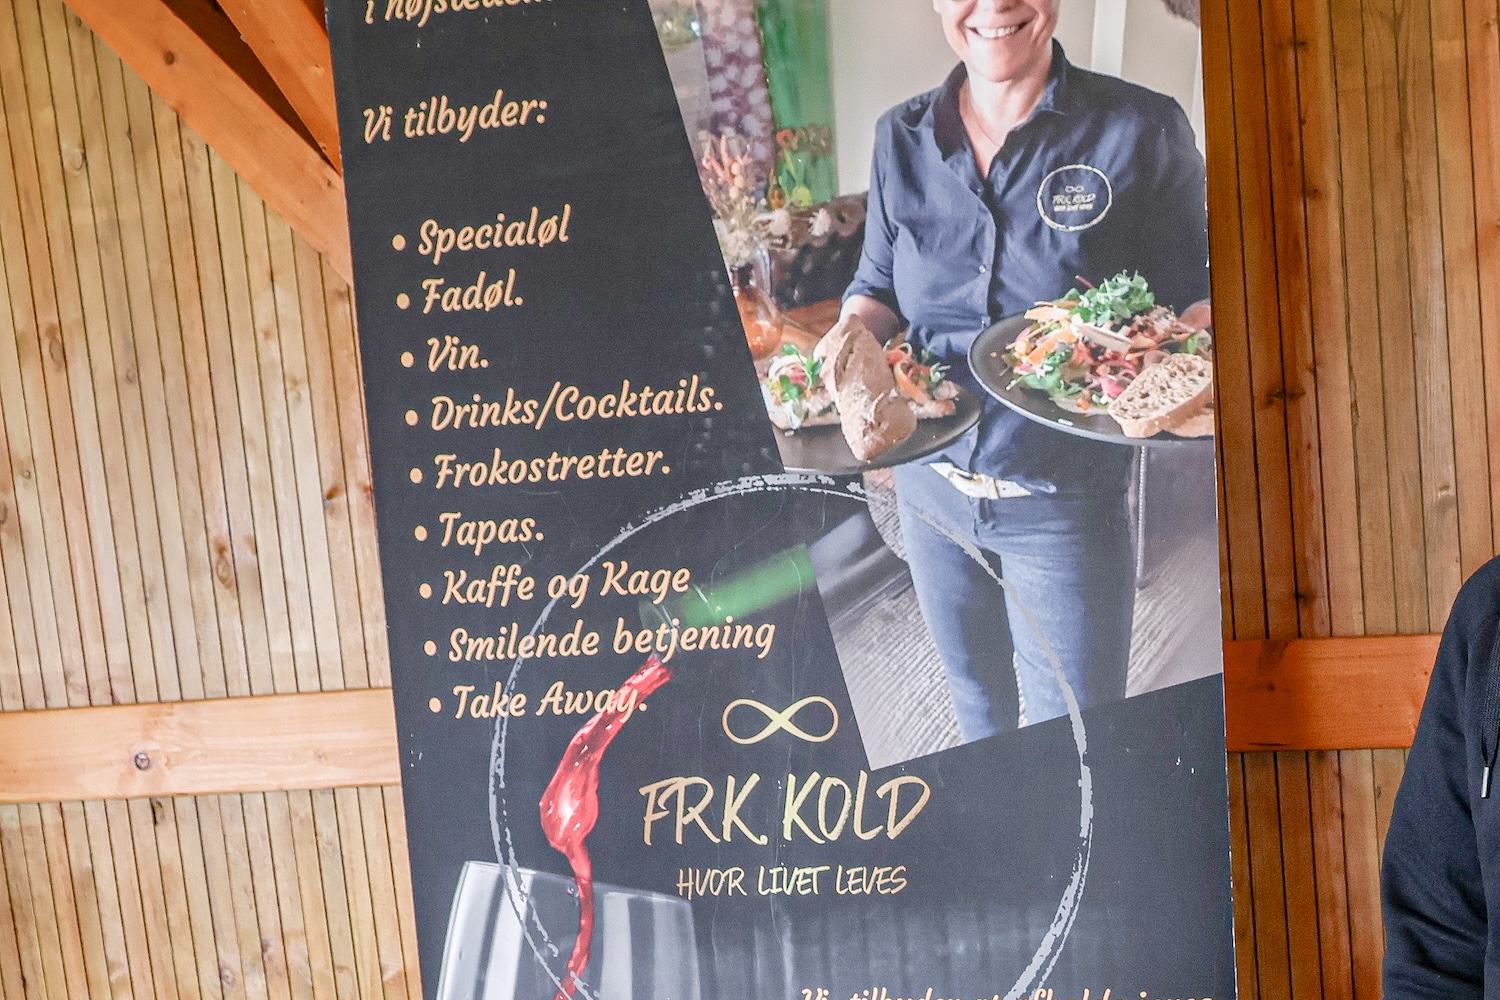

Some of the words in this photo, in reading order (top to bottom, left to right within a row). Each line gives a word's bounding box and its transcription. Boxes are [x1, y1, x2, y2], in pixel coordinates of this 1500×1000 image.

[363, 105, 394, 144] Vi
[404, 89, 548, 143] tilbyder:
[417, 203, 572, 265] Specialøl
[422, 269, 524, 314] Fadøl.
[427, 336, 489, 372] Vin.
[430, 375, 723, 430] Drinks/Cocktails.
[434, 447, 671, 489] Frokostretter.
[438, 512, 544, 556] Tapas.
[441, 563, 535, 606] Kaffe
[547, 572, 590, 608] og
[600, 561, 692, 605] Kage
[448, 618, 600, 662] Smilende
[613, 616, 776, 663] betjening
[453, 681, 527, 719] Take
[536, 680, 648, 724] Away.
[782, 770, 931, 845] KOLD
[676, 866, 747, 900] HVOR
[758, 865, 830, 896] LIVET
[835, 865, 908, 896] LEVES
